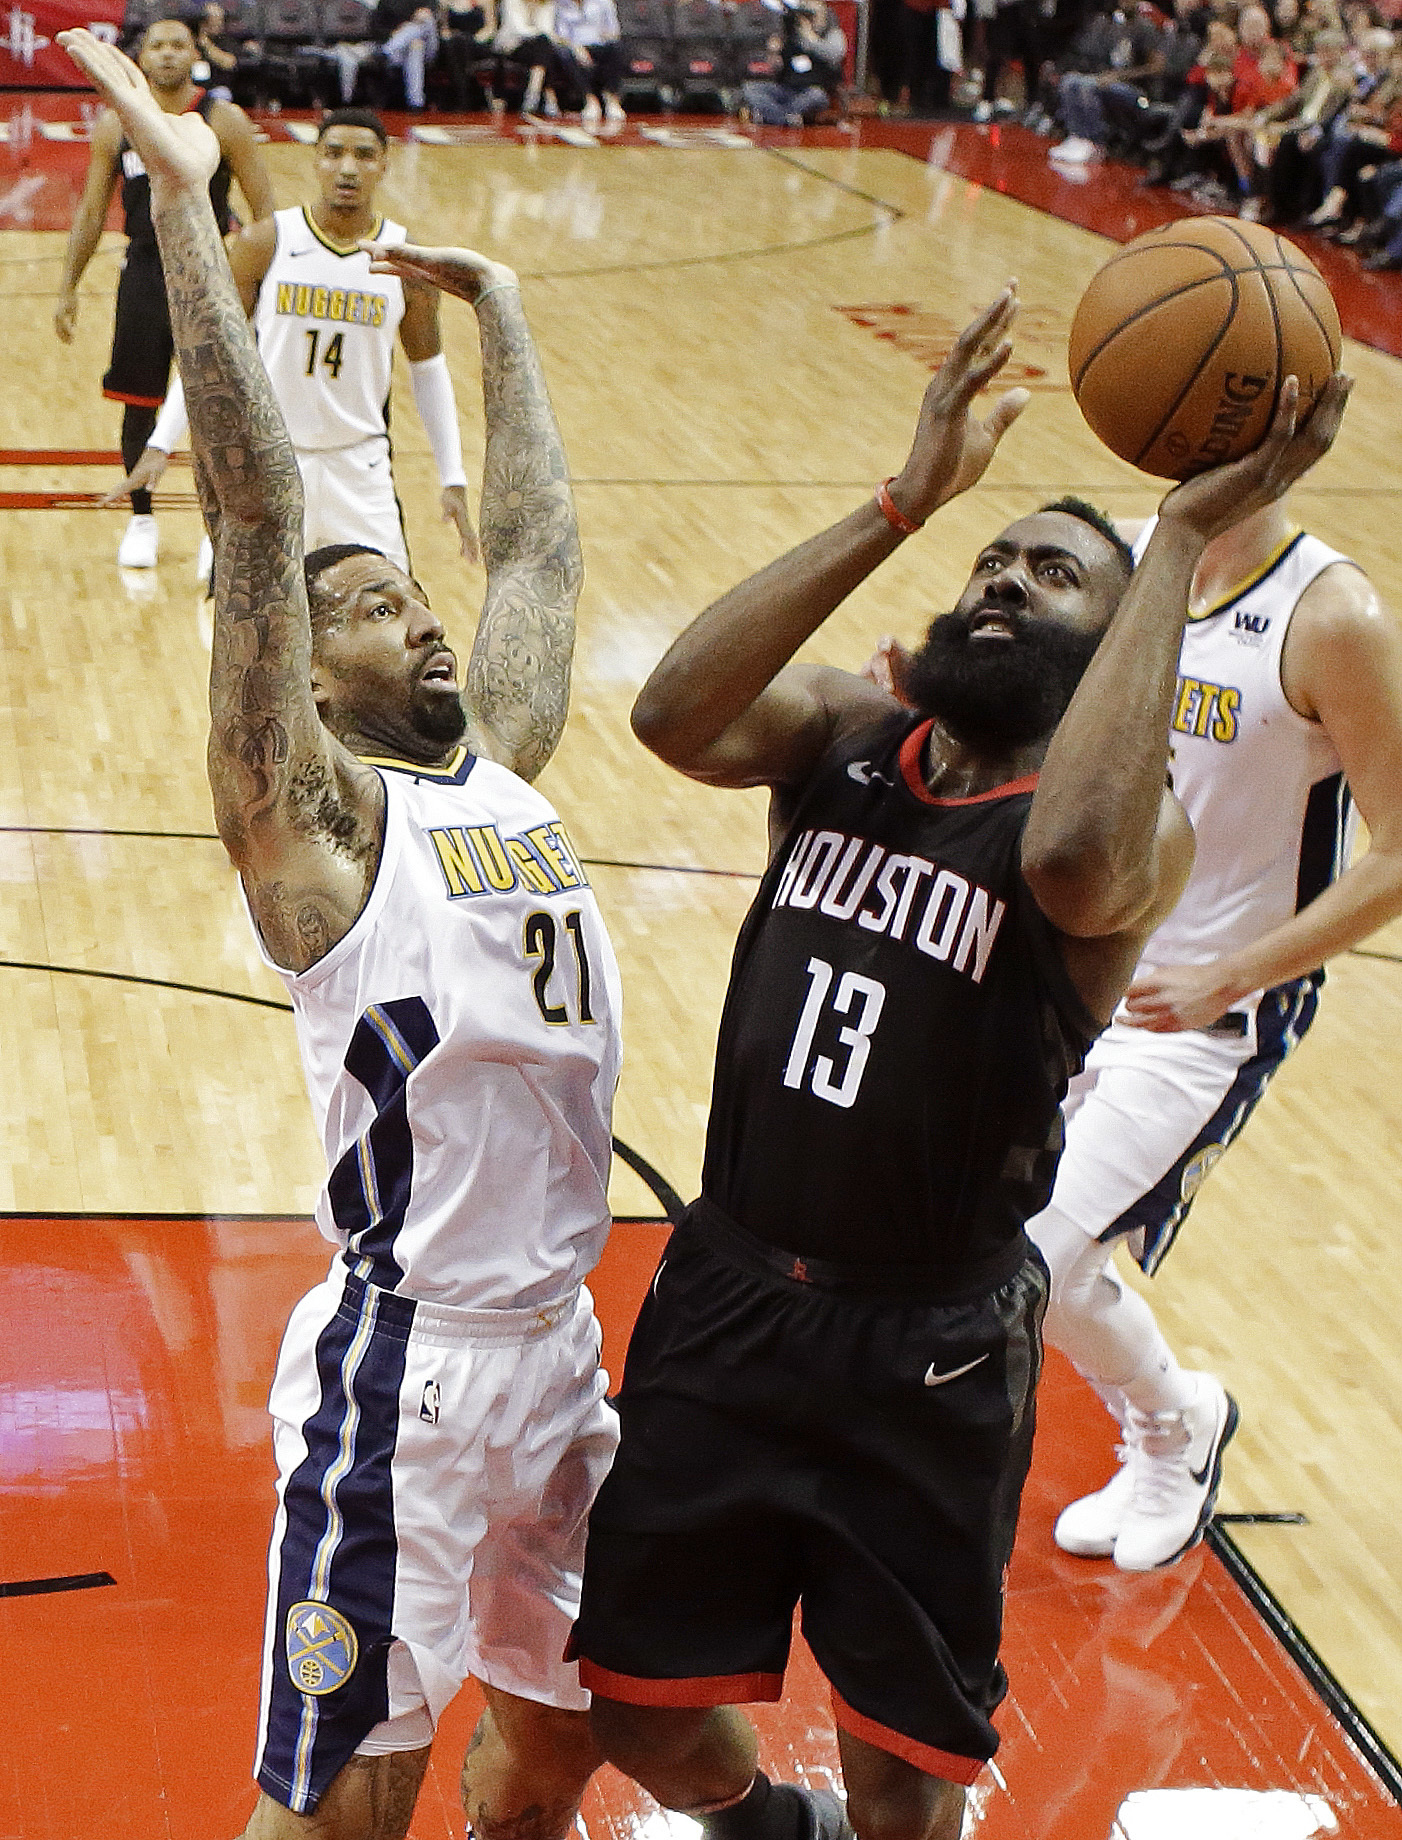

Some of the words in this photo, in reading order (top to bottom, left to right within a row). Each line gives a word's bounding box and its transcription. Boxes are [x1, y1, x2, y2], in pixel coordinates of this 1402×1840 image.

[275, 281, 390, 328] NUGGETS
[304, 329, 345, 378] 14
[1172, 674, 1243, 743] ETS
[771, 829, 1006, 985] HOUSTON
[523, 908, 598, 1027] 21
[783, 956, 887, 1109] 13
